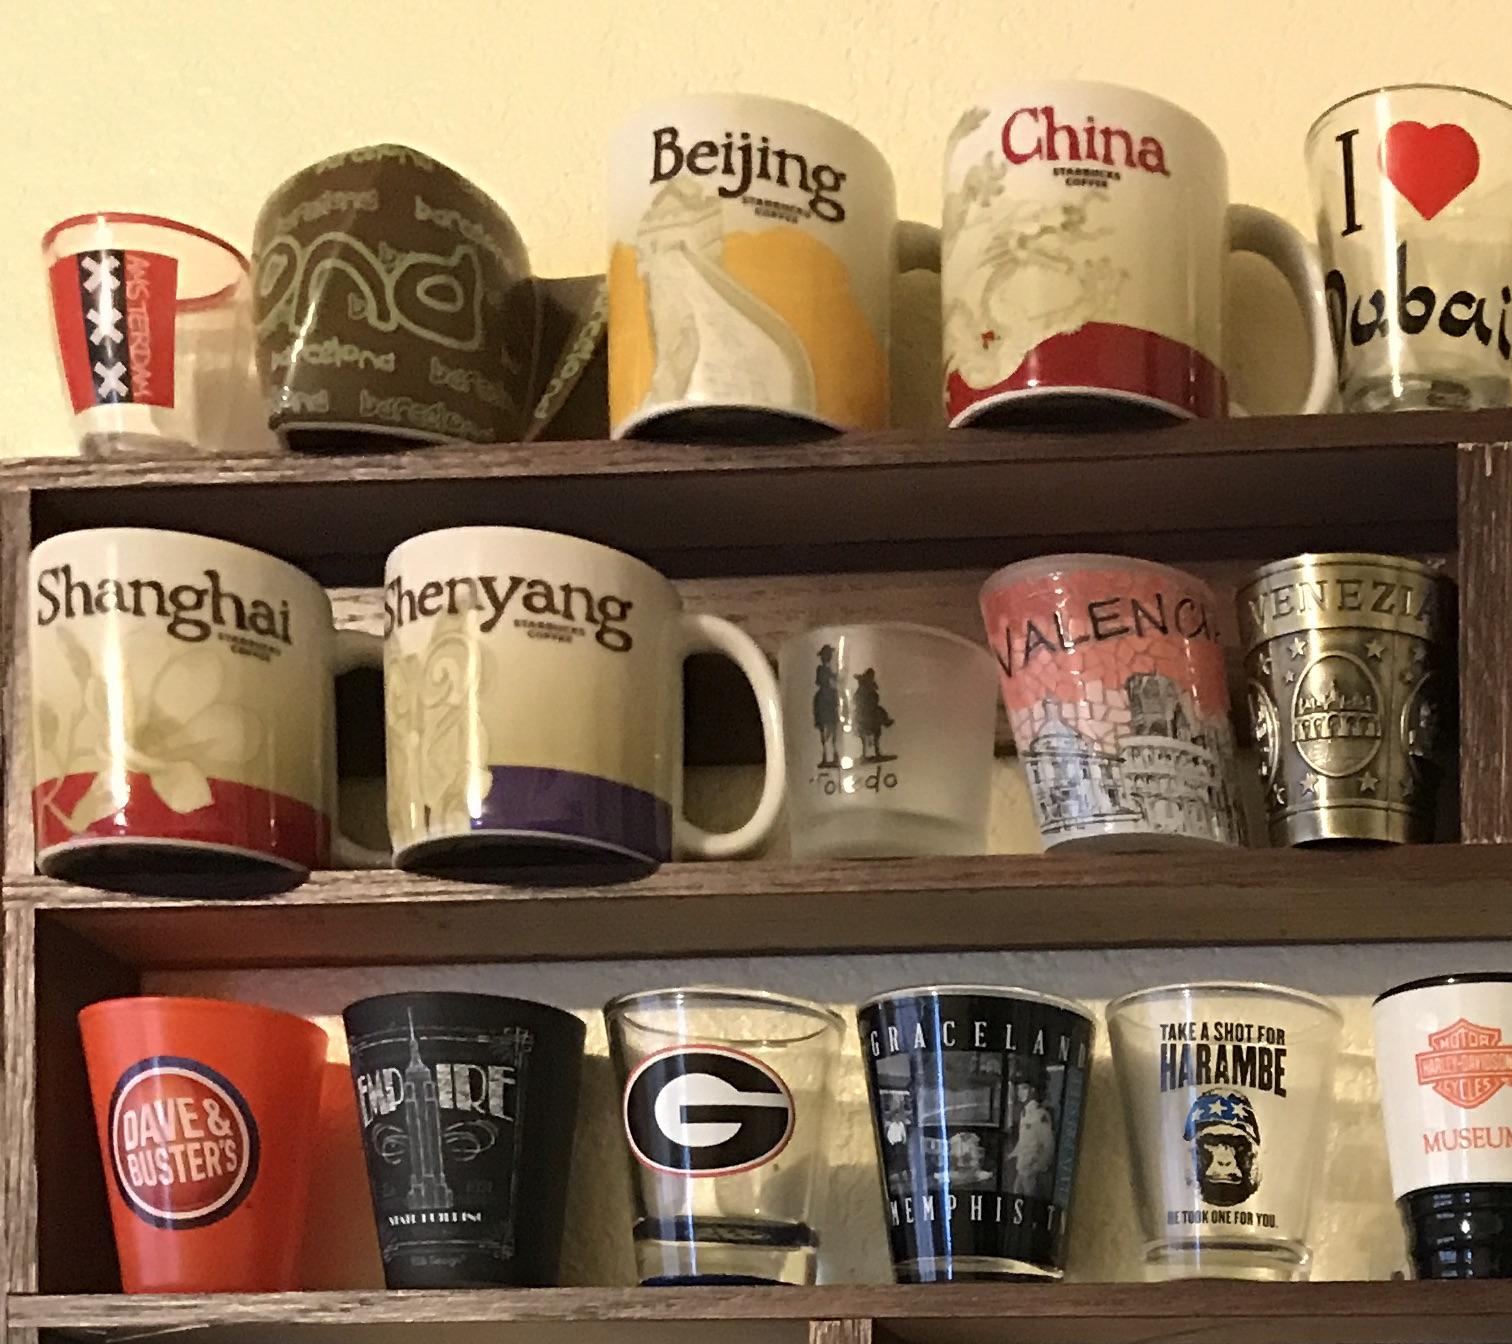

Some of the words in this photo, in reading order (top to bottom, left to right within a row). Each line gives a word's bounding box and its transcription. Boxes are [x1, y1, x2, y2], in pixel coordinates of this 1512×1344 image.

[1001, 106, 1171, 177] China
[650, 126, 846, 223] Beijing
[1053, 167, 1121, 181] STARBUCKS
[1064, 177, 1109, 188] COFFEE
[1335, 129, 1362, 237] I
[127, 254, 152, 400] AMSTERDAM
[37, 566, 293, 645] Shanghai
[1249, 580, 1431, 622] VENEZIA
[1160, 1022, 1198, 1043] TAKE
[1199, 1022, 1211, 1043] A
[1213, 1021, 1256, 1045] SHOT
[1257, 1023, 1287, 1047] FOR
[1439, 1032, 1491, 1050] MOTOR
[1160, 1042, 1288, 1099] HARAMBE
[1442, 1079, 1494, 1101] CYCLES
[123, 1097, 205, 1150] DAVE
[204, 1098, 233, 1137] &
[625, 1050, 790, 1172] G
[127, 1137, 238, 1188] BUSTER'S
[1167, 1210, 1180, 1226] HE
[1181, 1210, 1209, 1227] TOOK
[1210, 1211, 1233, 1226] ONE
[1234, 1211, 1254, 1227] FOR
